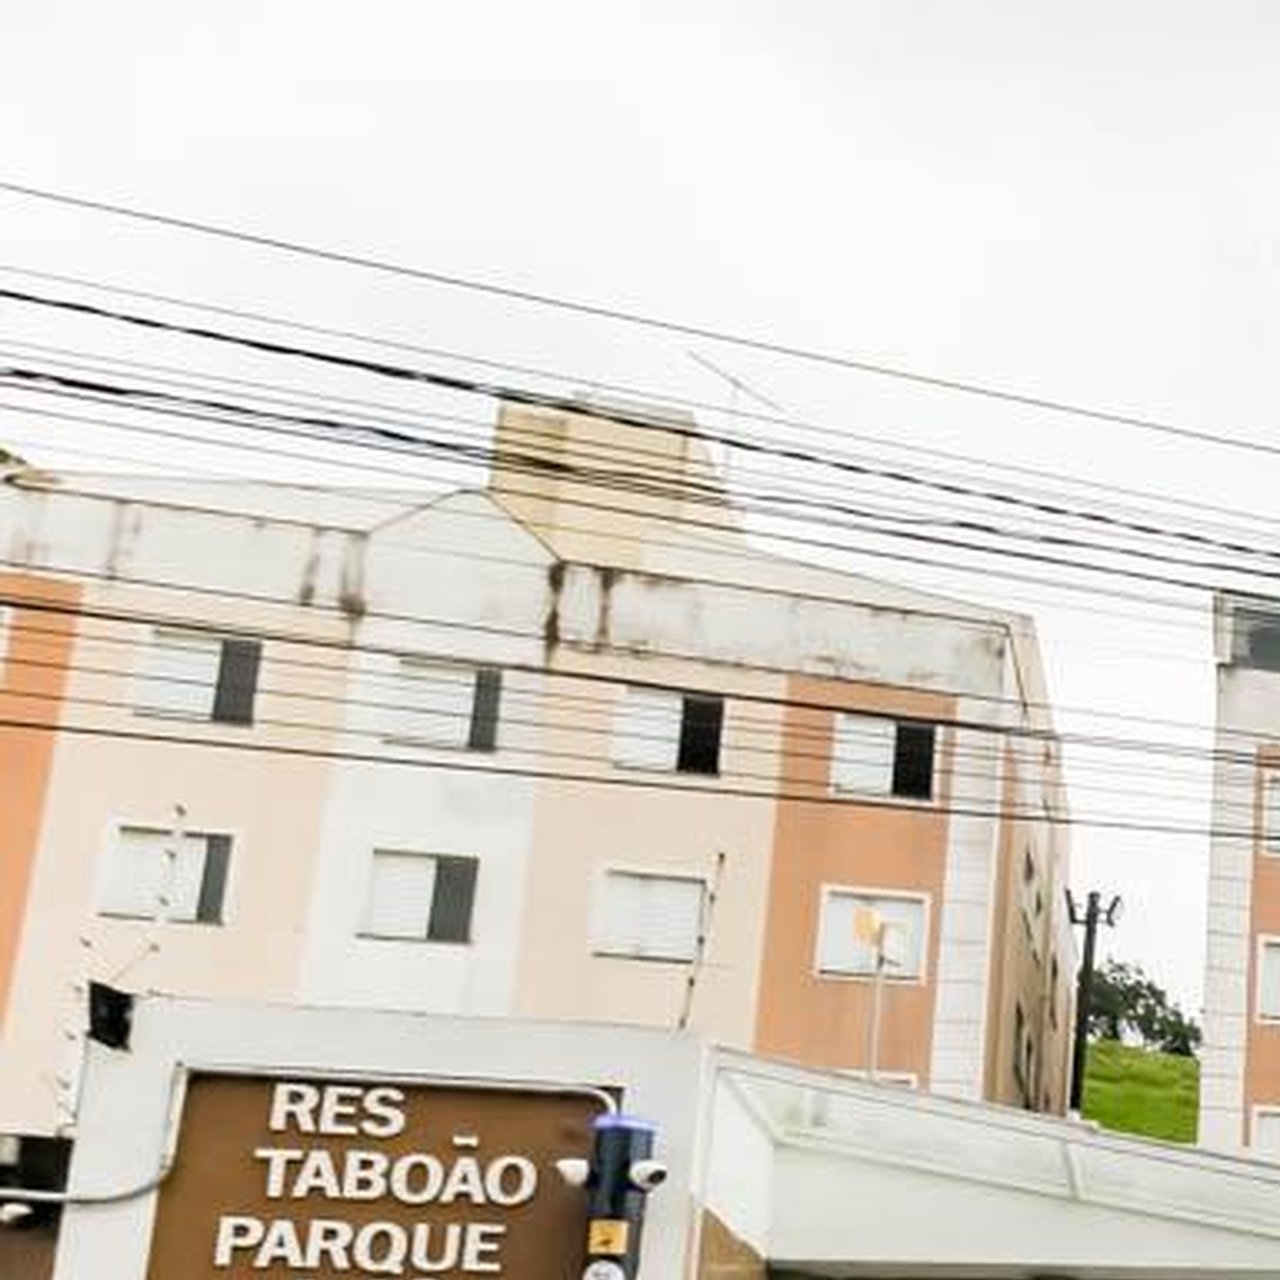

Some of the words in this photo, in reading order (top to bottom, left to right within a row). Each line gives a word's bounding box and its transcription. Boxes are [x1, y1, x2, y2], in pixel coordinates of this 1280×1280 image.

[269, 1083, 407, 1137] RES
[254, 1135, 538, 1205] TABOÃO
[213, 1216, 507, 1275] PARQUE
